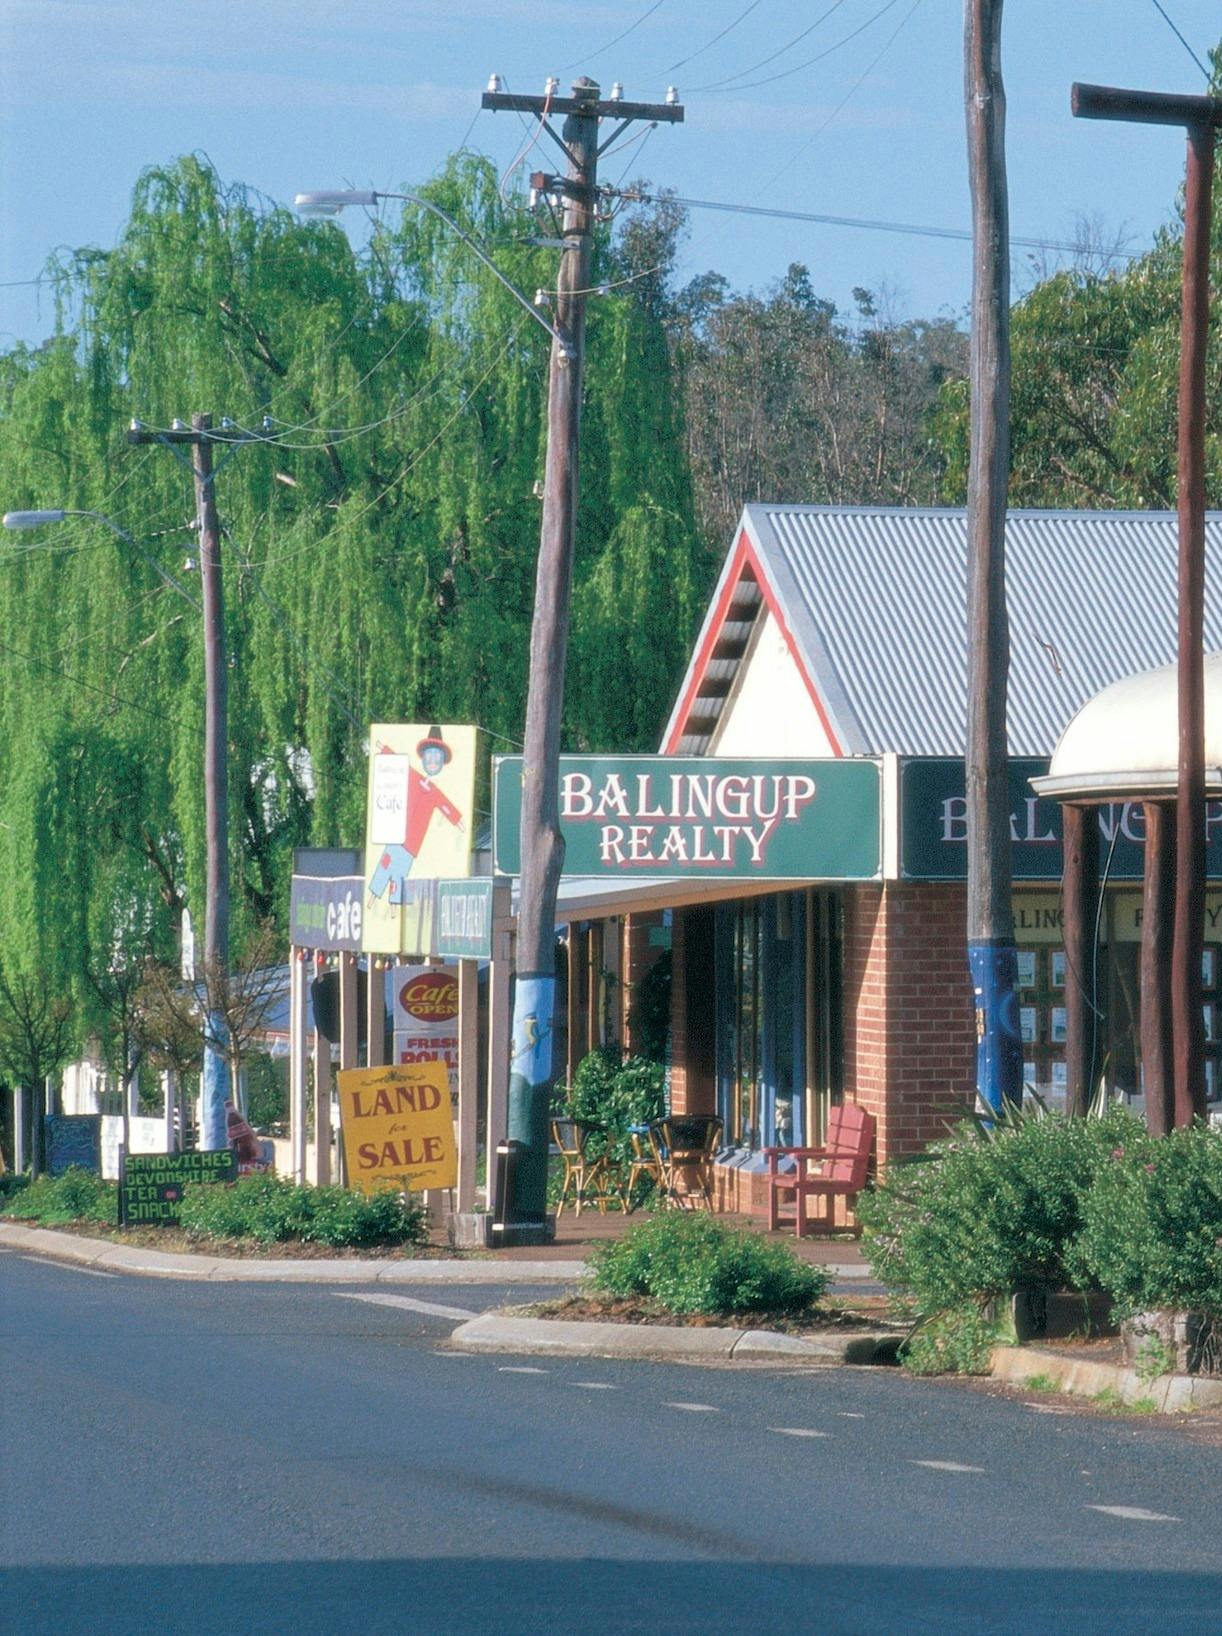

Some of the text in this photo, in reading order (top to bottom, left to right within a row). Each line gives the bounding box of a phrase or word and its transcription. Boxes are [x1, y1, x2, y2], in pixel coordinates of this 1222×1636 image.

[560, 773, 816, 819] BALINGUP
[599, 817, 776, 863] REALTY
[327, 890, 362, 941] cafe
[409, 1005, 459, 1015] OPEN
[352, 1084, 442, 1118] LAND
[388, 1122, 407, 1135] for
[124, 1152, 232, 1171] SANDWICHES
[358, 1136, 445, 1170] SALE
[127, 1169, 220, 1186] DEVONSHIRE
[123, 1186, 158, 1201] TEA
